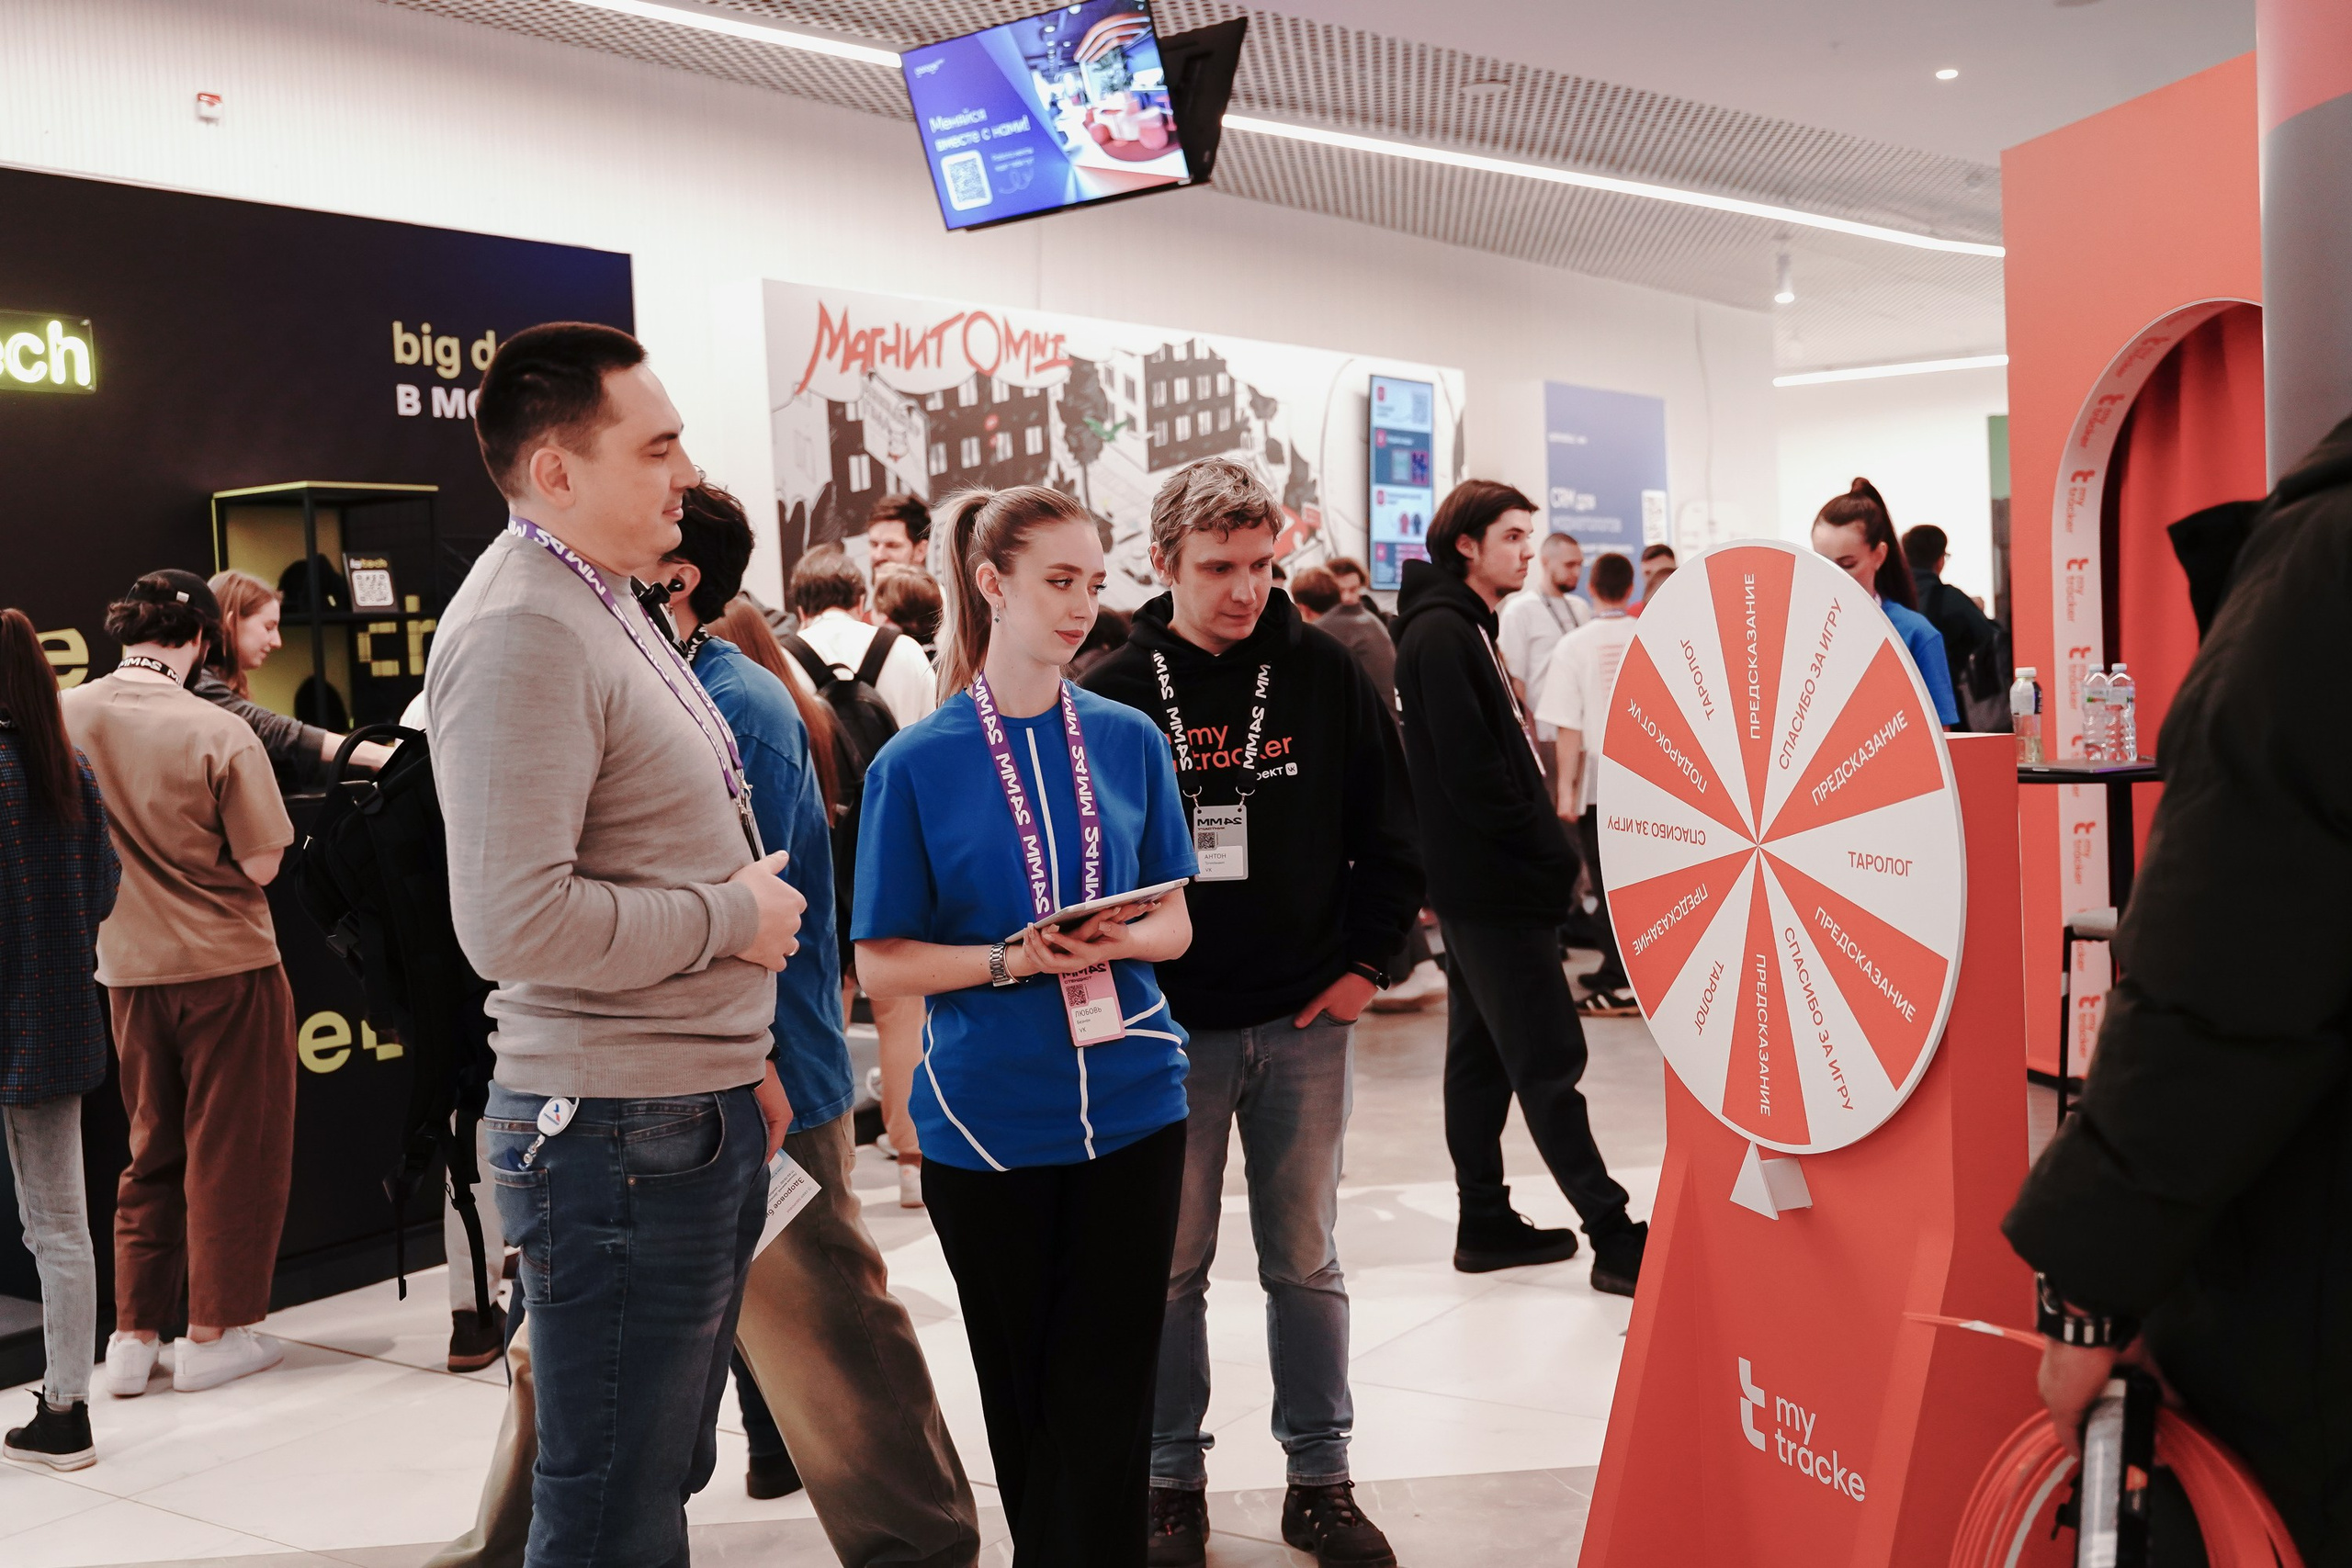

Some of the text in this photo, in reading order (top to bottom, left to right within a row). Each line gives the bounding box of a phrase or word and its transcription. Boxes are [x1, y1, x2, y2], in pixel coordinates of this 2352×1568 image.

[0, 320, 91, 387] ch
[392, 321, 497, 379] big d
[1679, 638, 1714, 721] ТАРОЛОГ
[1744, 572, 1761, 739] ПРЕДСКАЗАНИЕ
[1779, 597, 1842, 770] СПАСИБО ЗА ИГРУ
[1187, 726, 1228, 750] my
[1193, 737, 1293, 771] tracer
[1627, 698, 1708, 794] ПОДАРОК ОТ VK
[1811, 710, 1909, 806] ПРЕДСКАЗАНИЕ
[1607, 815, 1706, 845] СПАСИБО ЗА ИГРУ
[1848, 851, 1914, 877] ТАРОЛОГ
[1632, 882, 1708, 956] ПРЕДСКАЗАНИЕ
[1696, 958, 1725, 1036] ТАРОЛОГ
[1814, 905, 1917, 1023] ПРЕДСКАЗАНИЕ
[1075, 1007, 1102, 1018] ЛЮБОВЬ
[1754, 953, 1771, 1117] ПРЕДСКАЗАНИЕ
[1784, 927, 1854, 1111] СПАСИБО ЗА ИГРУ
[773, 1177, 805, 1209] Здоровое
[1775, 1395, 1816, 1446] my
[1774, 1427, 1866, 1502] tracke
